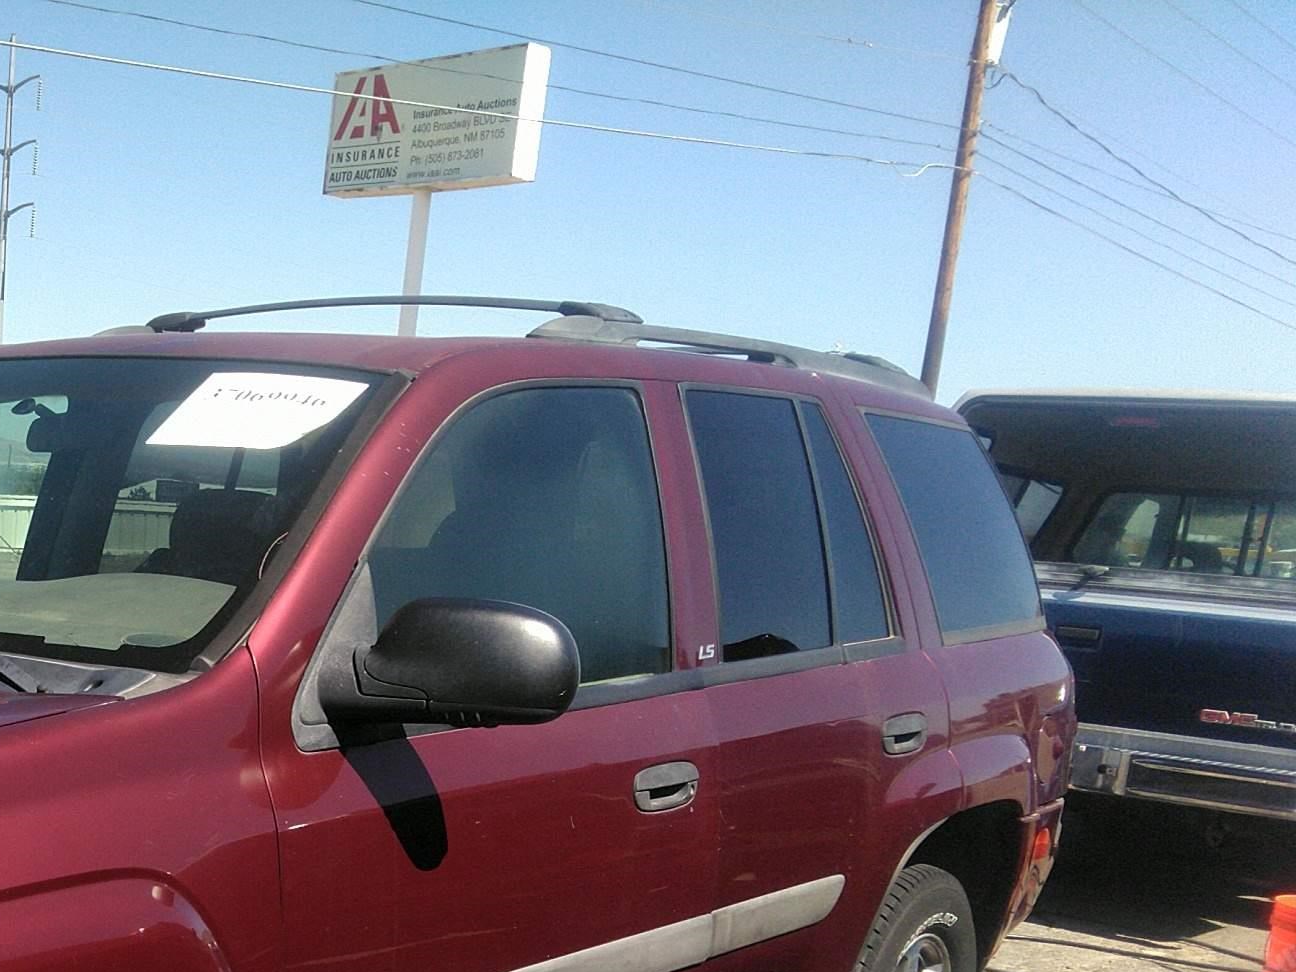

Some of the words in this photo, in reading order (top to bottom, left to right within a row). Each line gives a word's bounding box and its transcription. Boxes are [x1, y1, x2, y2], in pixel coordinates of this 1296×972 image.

[477, 97, 517, 111] Auctions
[433, 116, 472, 132] Broadway
[463, 131, 479, 144] NM
[331, 146, 400, 164] INSURANCE
[329, 171, 352, 183] AUTO
[353, 166, 398, 180] AUCTIONS
[698, 643, 715, 661] LS
